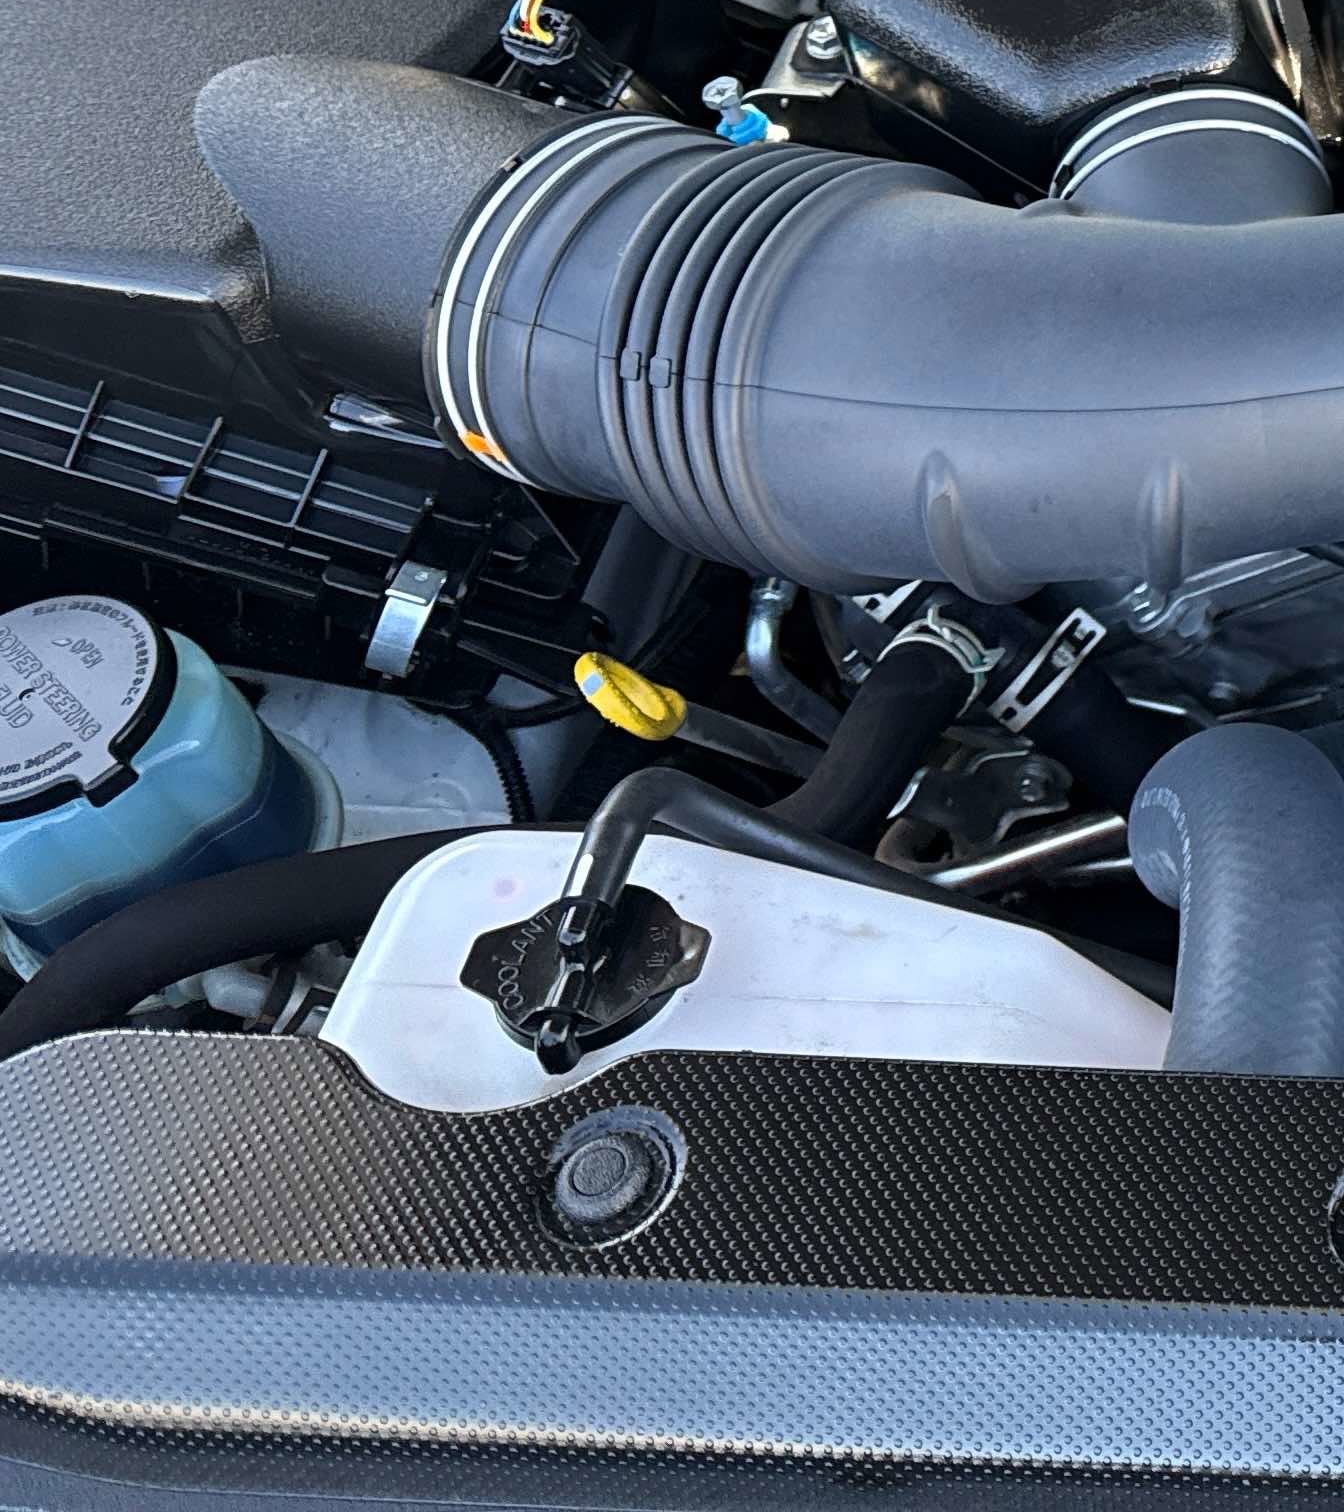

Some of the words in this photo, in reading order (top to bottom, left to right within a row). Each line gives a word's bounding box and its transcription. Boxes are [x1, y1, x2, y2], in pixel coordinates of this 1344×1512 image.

[70, 638, 104, 670] OPEN
[31, 671, 103, 742] STEERING
[497, 909, 555, 1010] COOLANT
